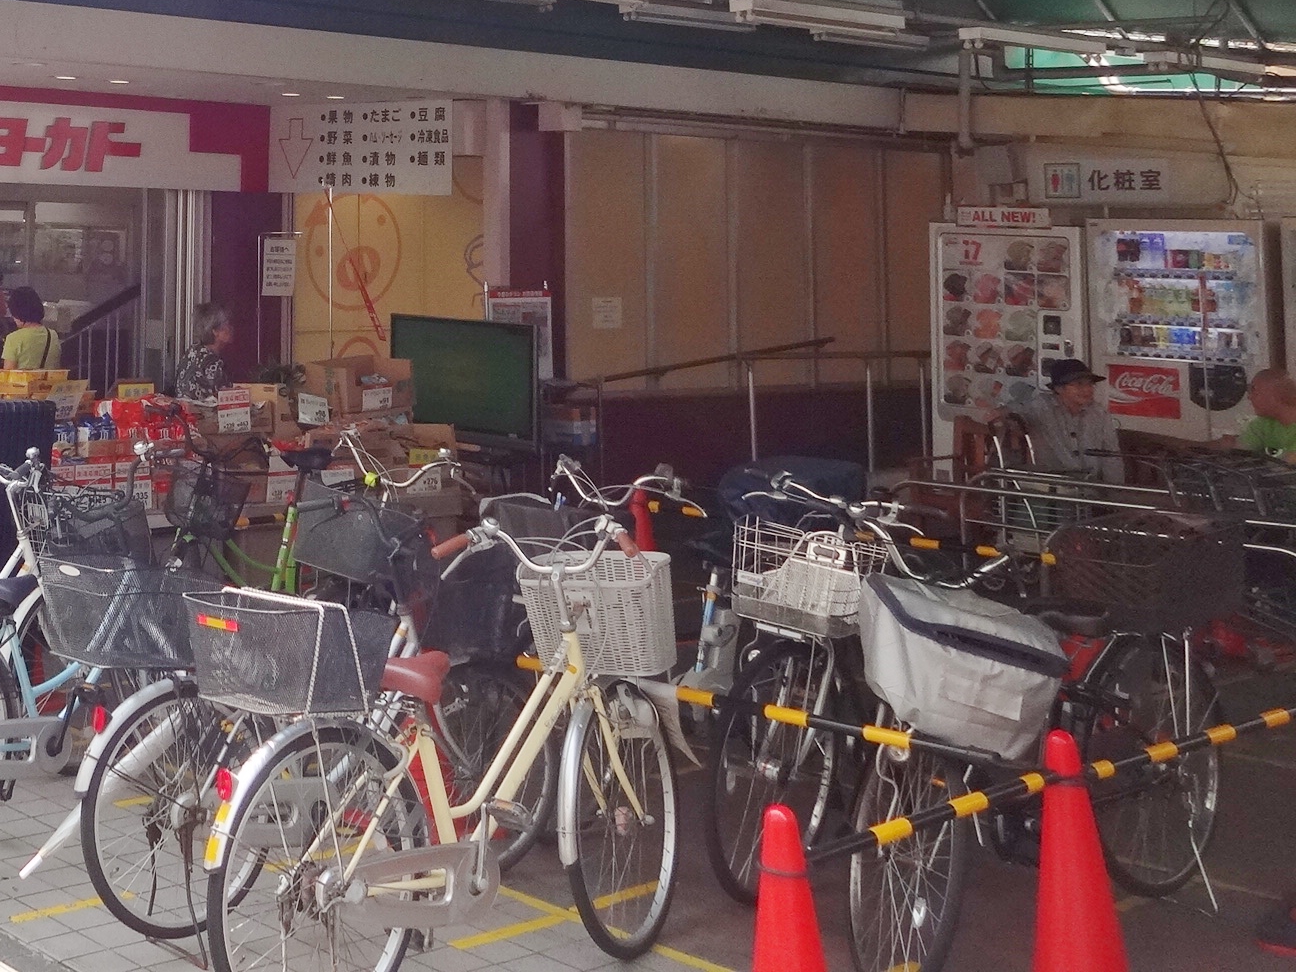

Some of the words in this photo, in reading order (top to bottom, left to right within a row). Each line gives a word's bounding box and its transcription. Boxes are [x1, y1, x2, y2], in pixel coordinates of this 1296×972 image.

[327, 110, 354, 124] 果物
[370, 108, 402, 123] たまご
[417, 107, 446, 122] 豆腐
[326, 130, 353, 145] 野菜
[417, 129, 449, 144] 冷凍食品
[326, 151, 353, 166] 鮮魚
[369, 151, 396, 166] 漬物
[369, 173, 396, 188] 練物
[1088, 169, 1162, 191] 化粧室
[972, 210, 997, 223] ALL
[1000, 211, 1037, 224] NEW!
[1114, 371, 1177, 395] Coca-Cola
